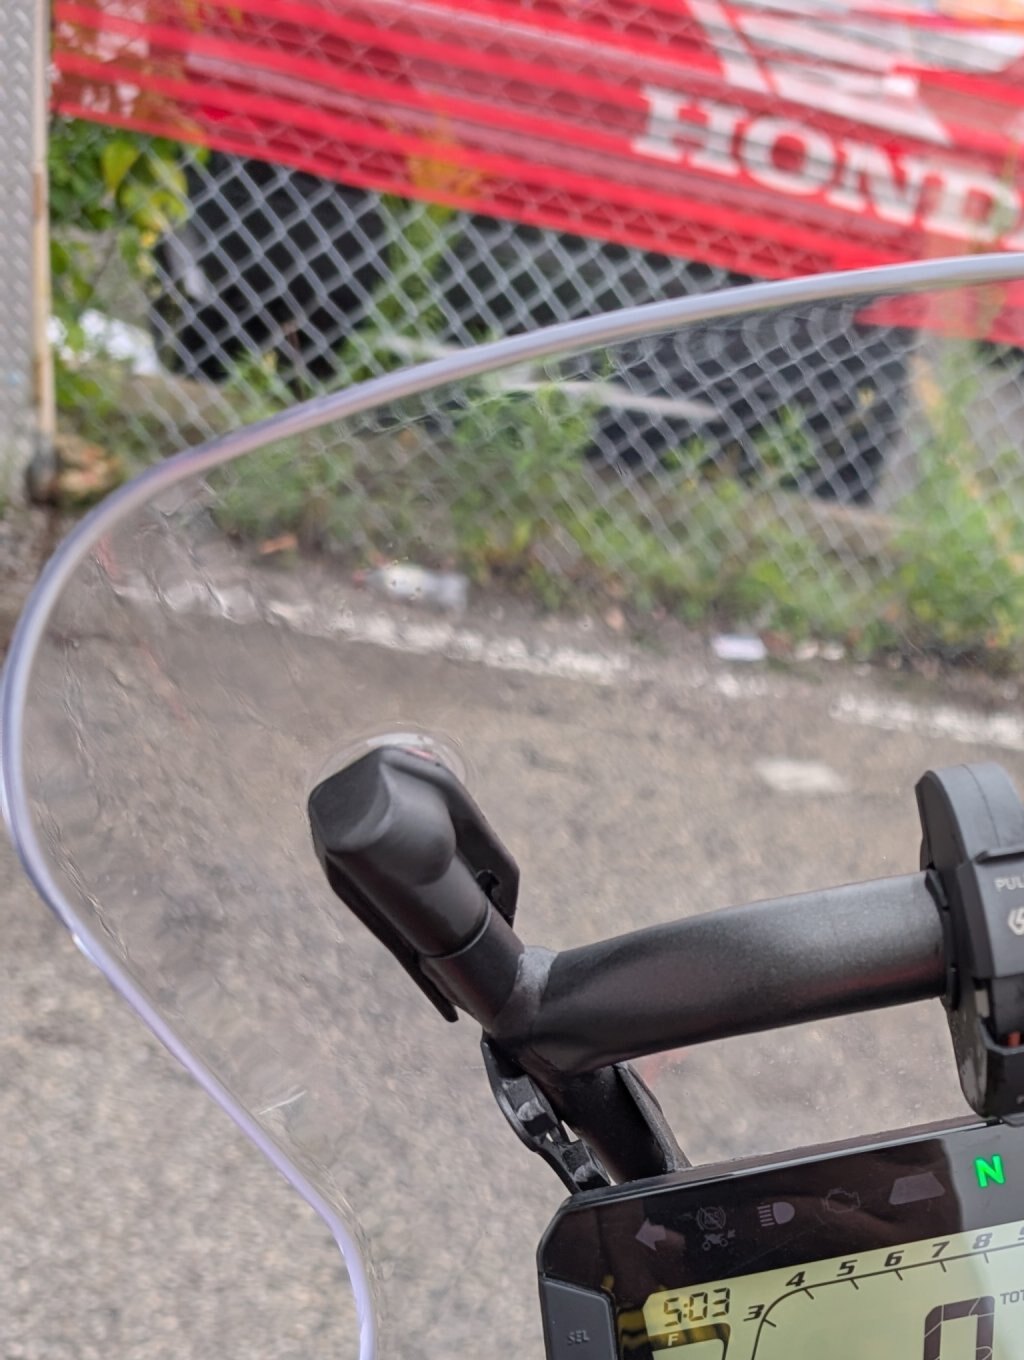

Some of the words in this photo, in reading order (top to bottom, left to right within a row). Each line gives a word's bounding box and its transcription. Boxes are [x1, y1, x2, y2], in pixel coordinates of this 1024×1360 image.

[974, 1154, 1006, 1188] N
[973, 1233, 993, 1249] 8
[932, 1241, 950, 1258] 7
[885, 1251, 905, 1267] 6
[837, 1259, 858, 1276] 5
[786, 1271, 806, 1287] 4
[663, 1287, 731, 1327] 5:03
[744, 1305, 765, 1321] 3
[567, 1329, 590, 1345] SEL
[666, 1334, 681, 1347] F
